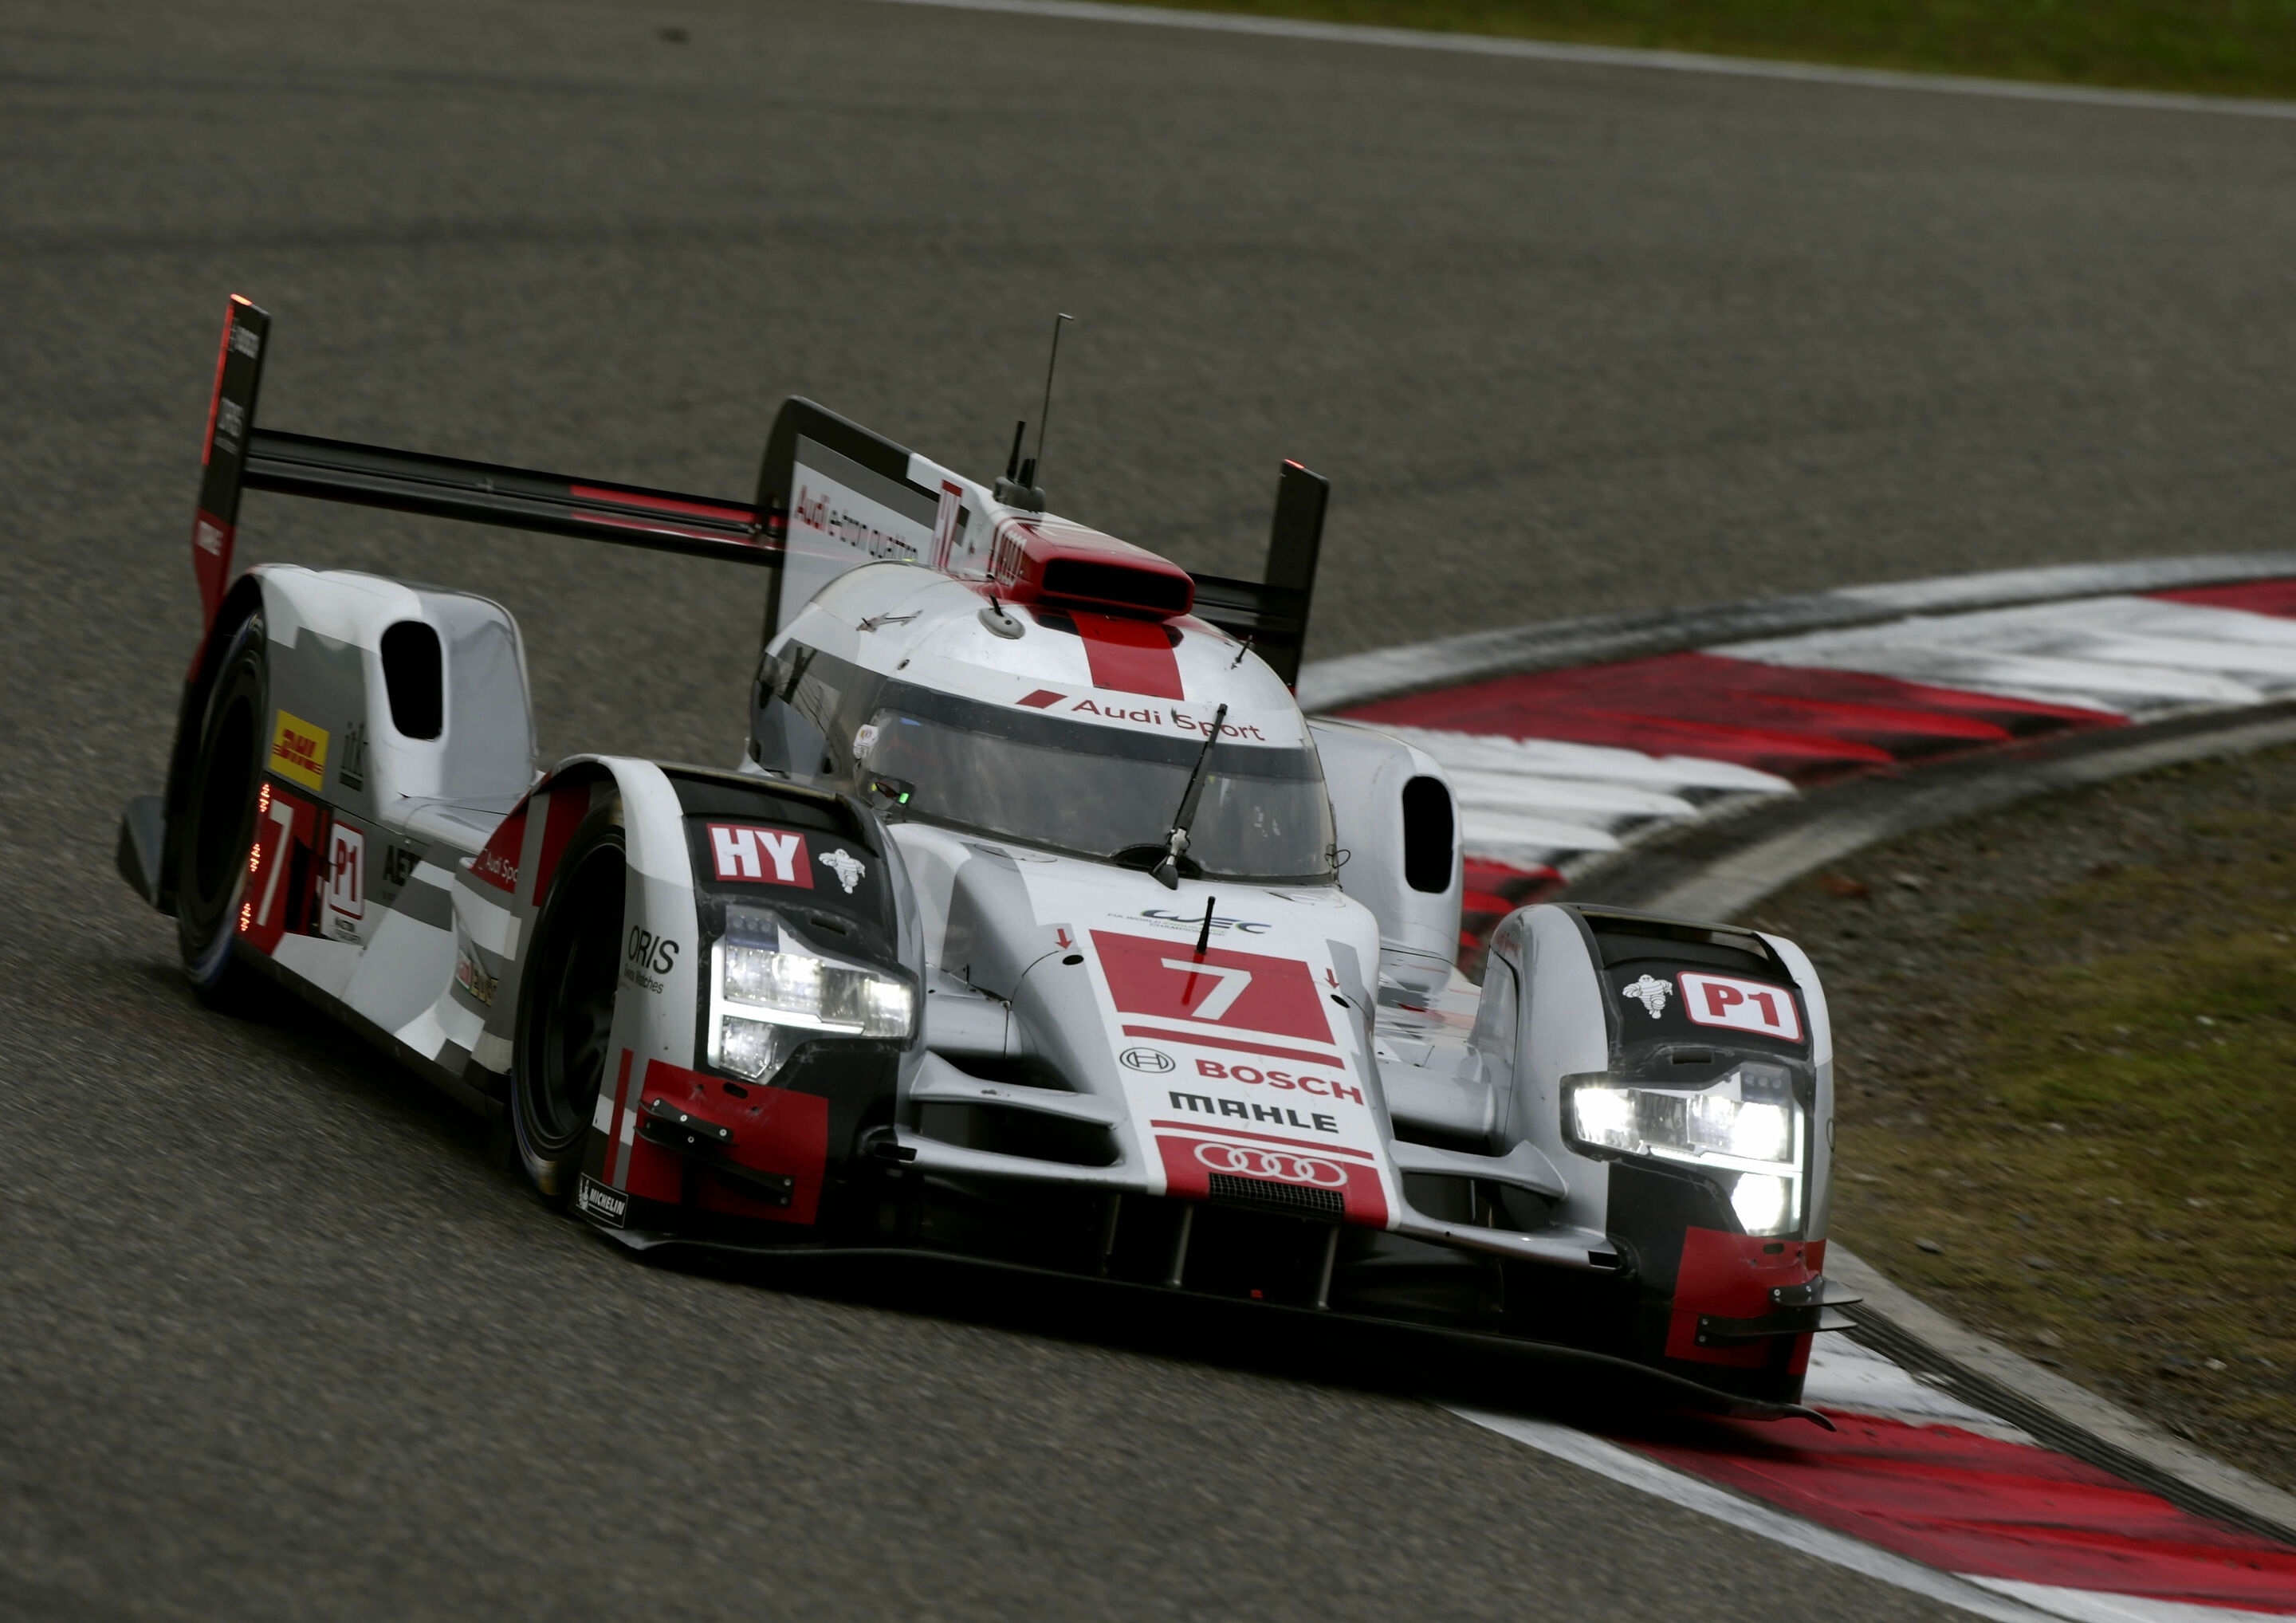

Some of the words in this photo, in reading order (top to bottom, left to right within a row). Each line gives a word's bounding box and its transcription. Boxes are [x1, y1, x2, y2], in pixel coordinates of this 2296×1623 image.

[794, 485, 831, 532] Audi
[1071, 699, 1162, 725] Audi
[1174, 713, 1266, 742] Sport
[257, 798, 295, 927] 7
[333, 838, 358, 903] P1
[485, 851, 503, 875] Audi
[711, 827, 801, 882] HY
[1126, 916, 1163, 925] WORLD
[1140, 909, 1272, 935] WEC
[628, 925, 680, 975] ORIS
[1160, 957, 1253, 1021] 7
[1701, 981, 1781, 1028] P1
[1194, 1058, 1364, 1106] BOSCH
[1168, 1090, 1339, 1134] MAHLE
[588, 1187, 626, 1216] MICHELIN
